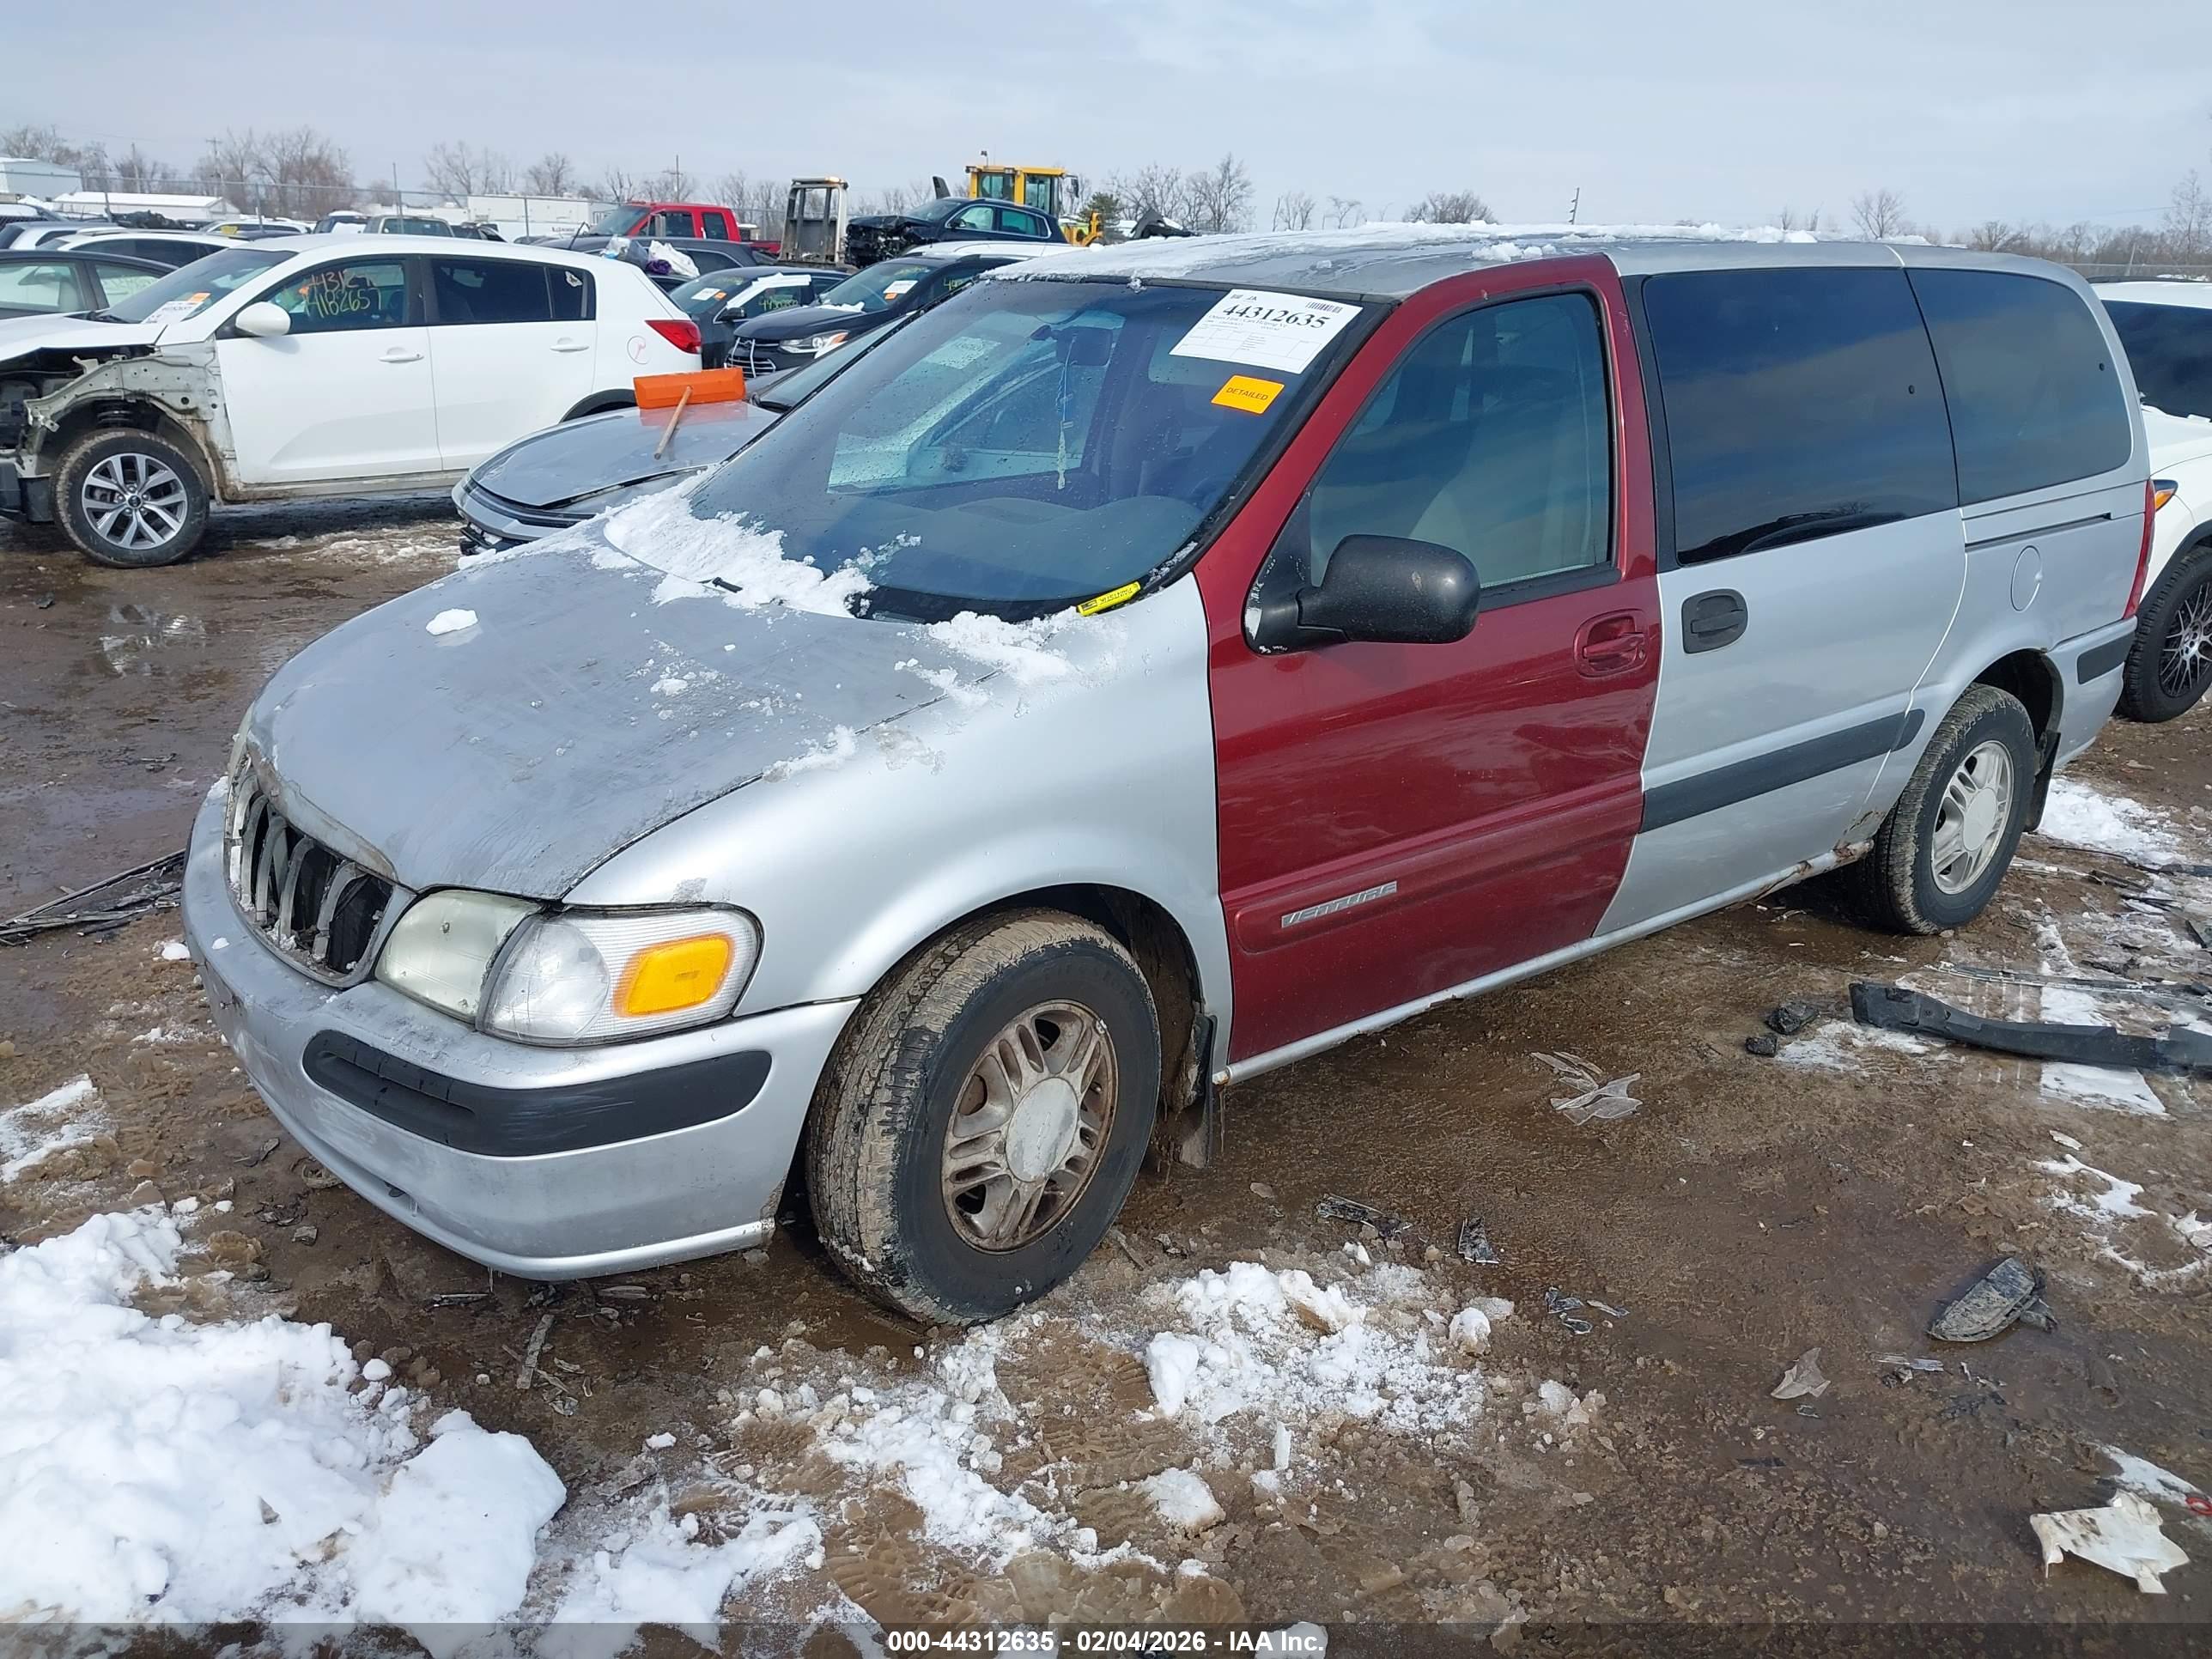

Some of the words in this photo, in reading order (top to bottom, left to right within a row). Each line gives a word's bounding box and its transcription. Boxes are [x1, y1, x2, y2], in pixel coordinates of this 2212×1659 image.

[1222, 303, 1330, 328] 44312635
[1225, 386, 1269, 401] DETAILED
[1281, 880, 1399, 928] VENTURE
